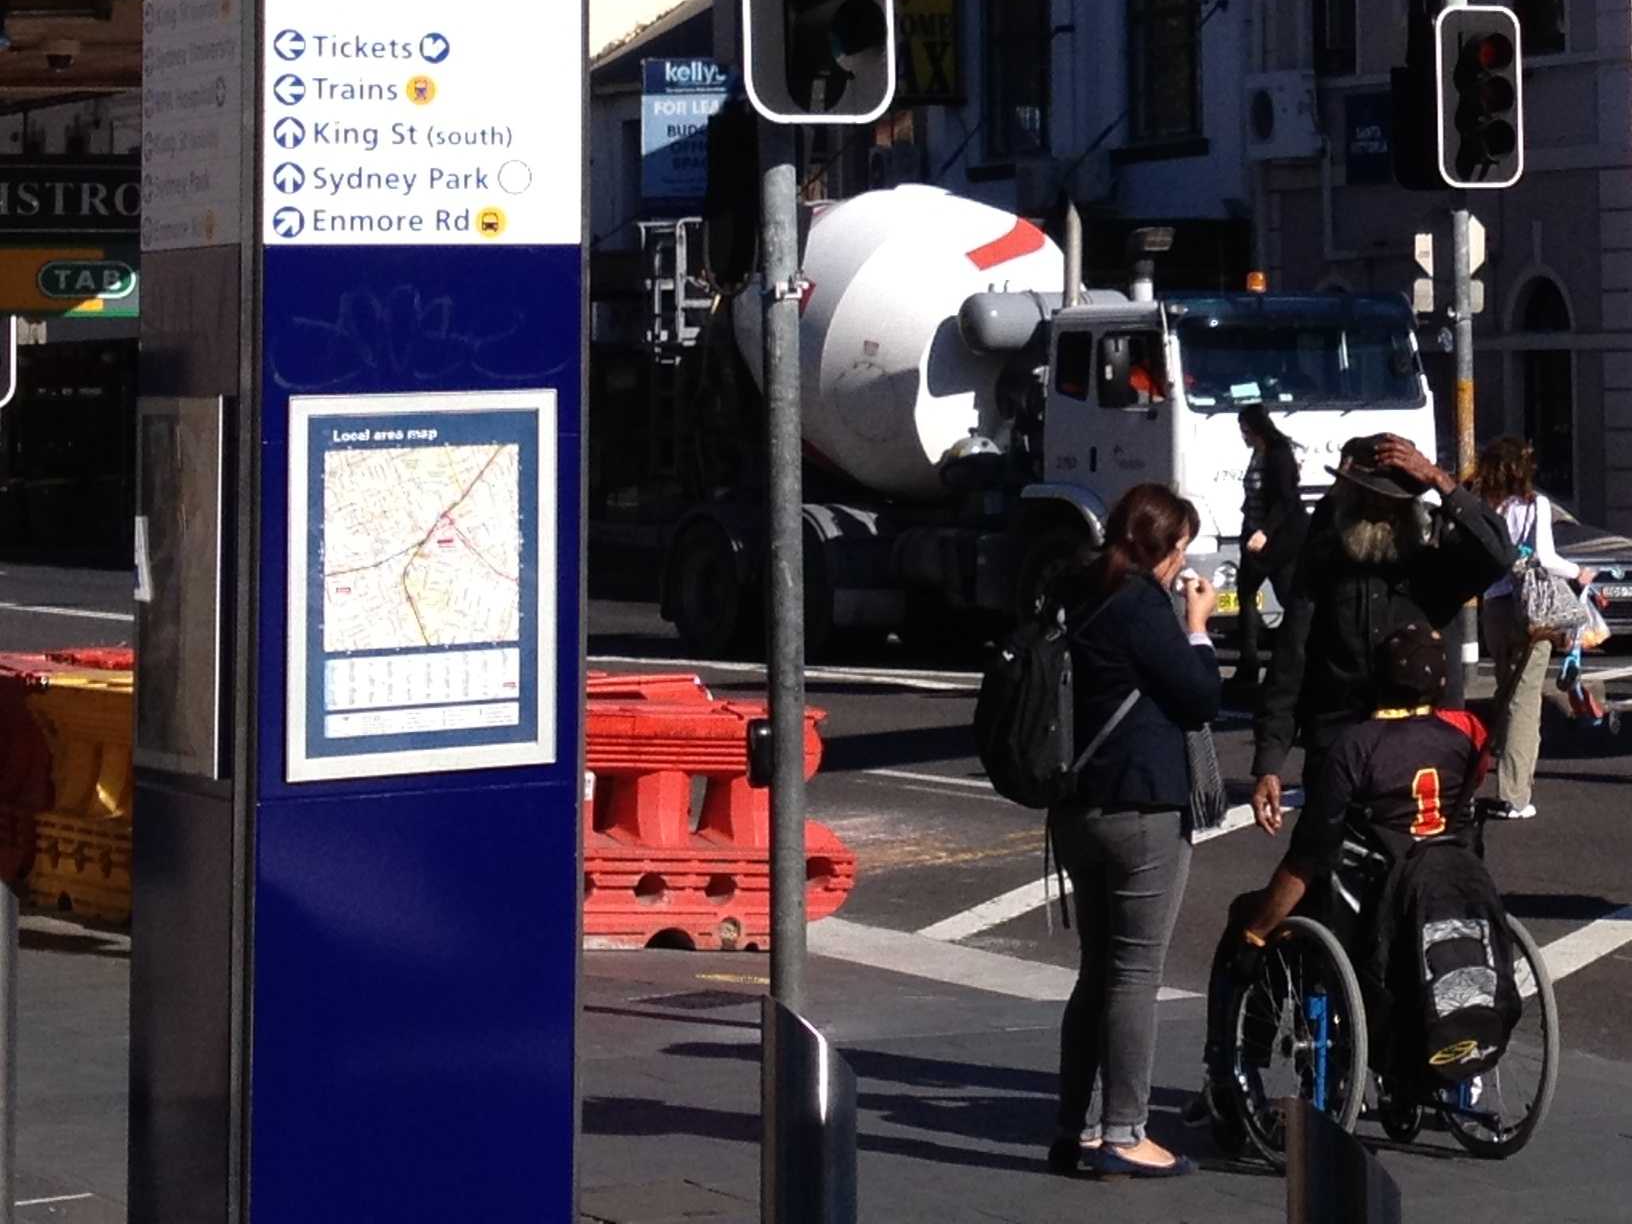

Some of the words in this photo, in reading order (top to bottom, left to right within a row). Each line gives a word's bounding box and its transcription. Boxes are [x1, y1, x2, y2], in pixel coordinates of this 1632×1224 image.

[313, 34, 413, 59] Tickets
[313, 77, 398, 100] Trains
[654, 100, 687, 115] FOR
[314, 121, 379, 151] King
[391, 123, 418, 145] St
[427, 126, 513, 148] (south)
[313, 166, 417, 195] Sydney
[430, 167, 488, 189] Park
[313, 209, 423, 231] Enmore
[436, 208, 469, 231] Rd
[53, 269, 122, 290] TAB
[333, 429, 370, 442] Local
[373, 430, 404, 441] area
[407, 429, 438, 441] map
[1410, 768, 1446, 835] 1
